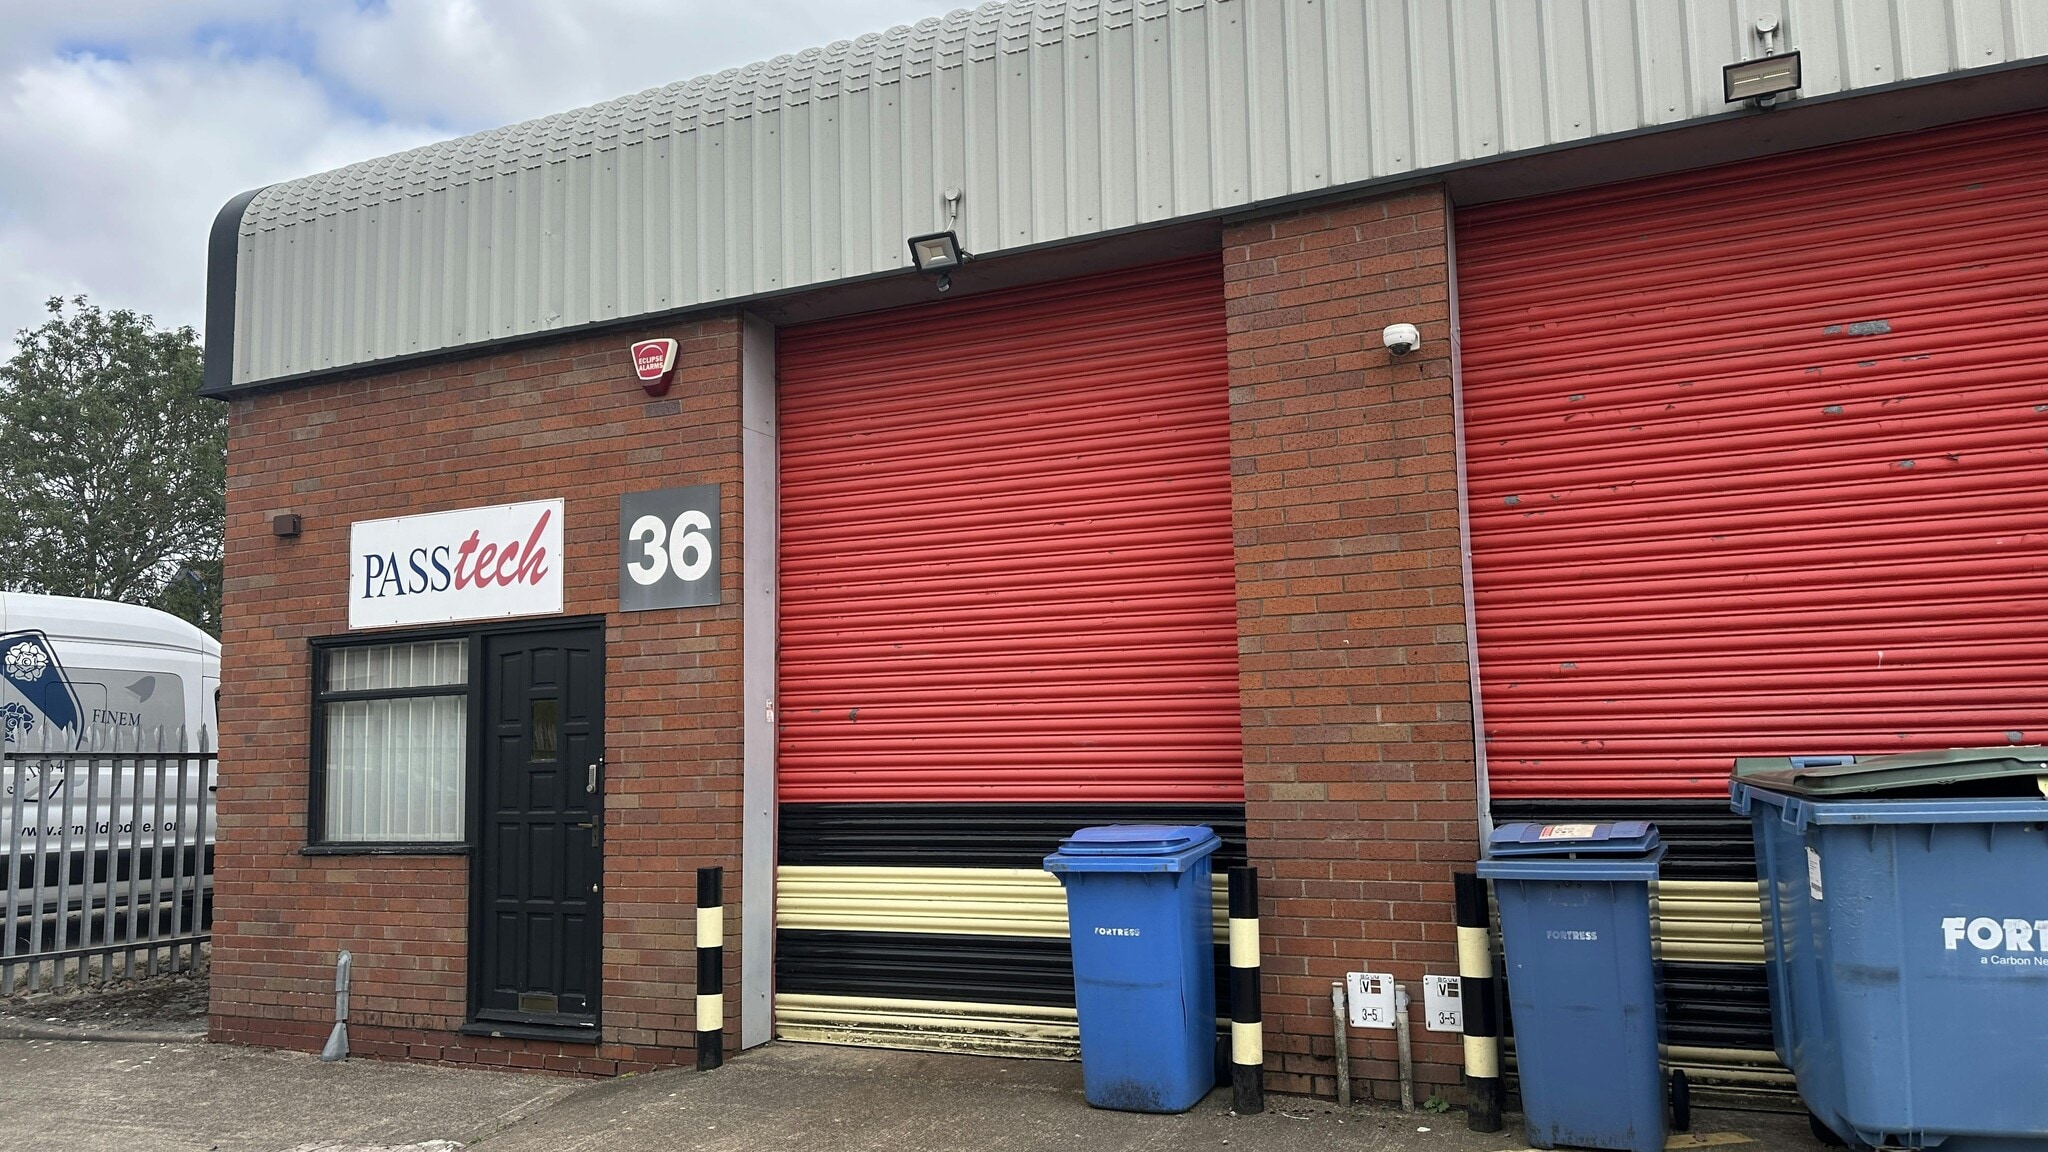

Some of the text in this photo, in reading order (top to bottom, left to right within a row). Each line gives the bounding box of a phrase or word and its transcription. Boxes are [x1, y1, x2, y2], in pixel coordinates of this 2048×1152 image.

[639, 355, 664, 364] ECLIPSE
[639, 362, 664, 371] ALARMS
[362, 509, 551, 598] PASStech
[627, 510, 713, 585] 36
[92, 708, 141, 726] FINEM
[1546, 930, 1597, 940] FORTRESS
[1991, 955, 2030, 965] Carbon
[1362, 981, 1369, 993] V
[1439, 984, 1446, 996] V
[1362, 1008, 1378, 1021] 3-5
[1439, 1012, 1455, 1025] 3-5
